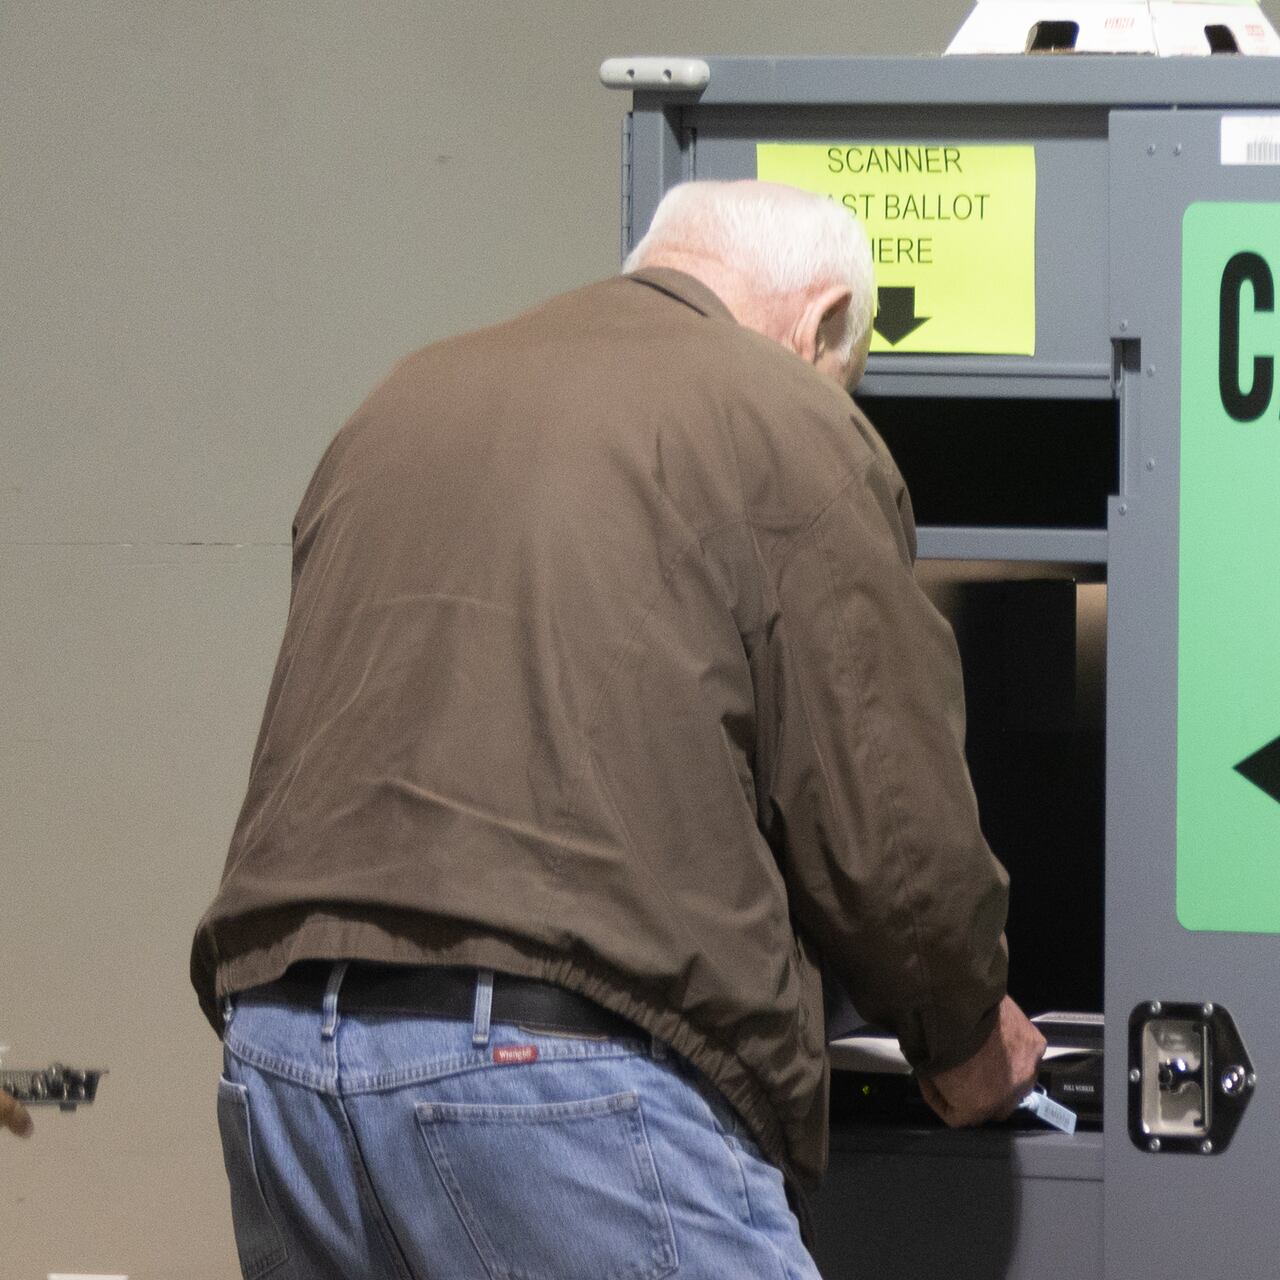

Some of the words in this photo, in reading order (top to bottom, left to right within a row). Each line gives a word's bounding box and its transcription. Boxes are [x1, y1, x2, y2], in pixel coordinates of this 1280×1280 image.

[827, 147, 963, 173] SCANNER
[884, 193, 990, 220] BALLOT
[871, 237, 933, 264] ERE
